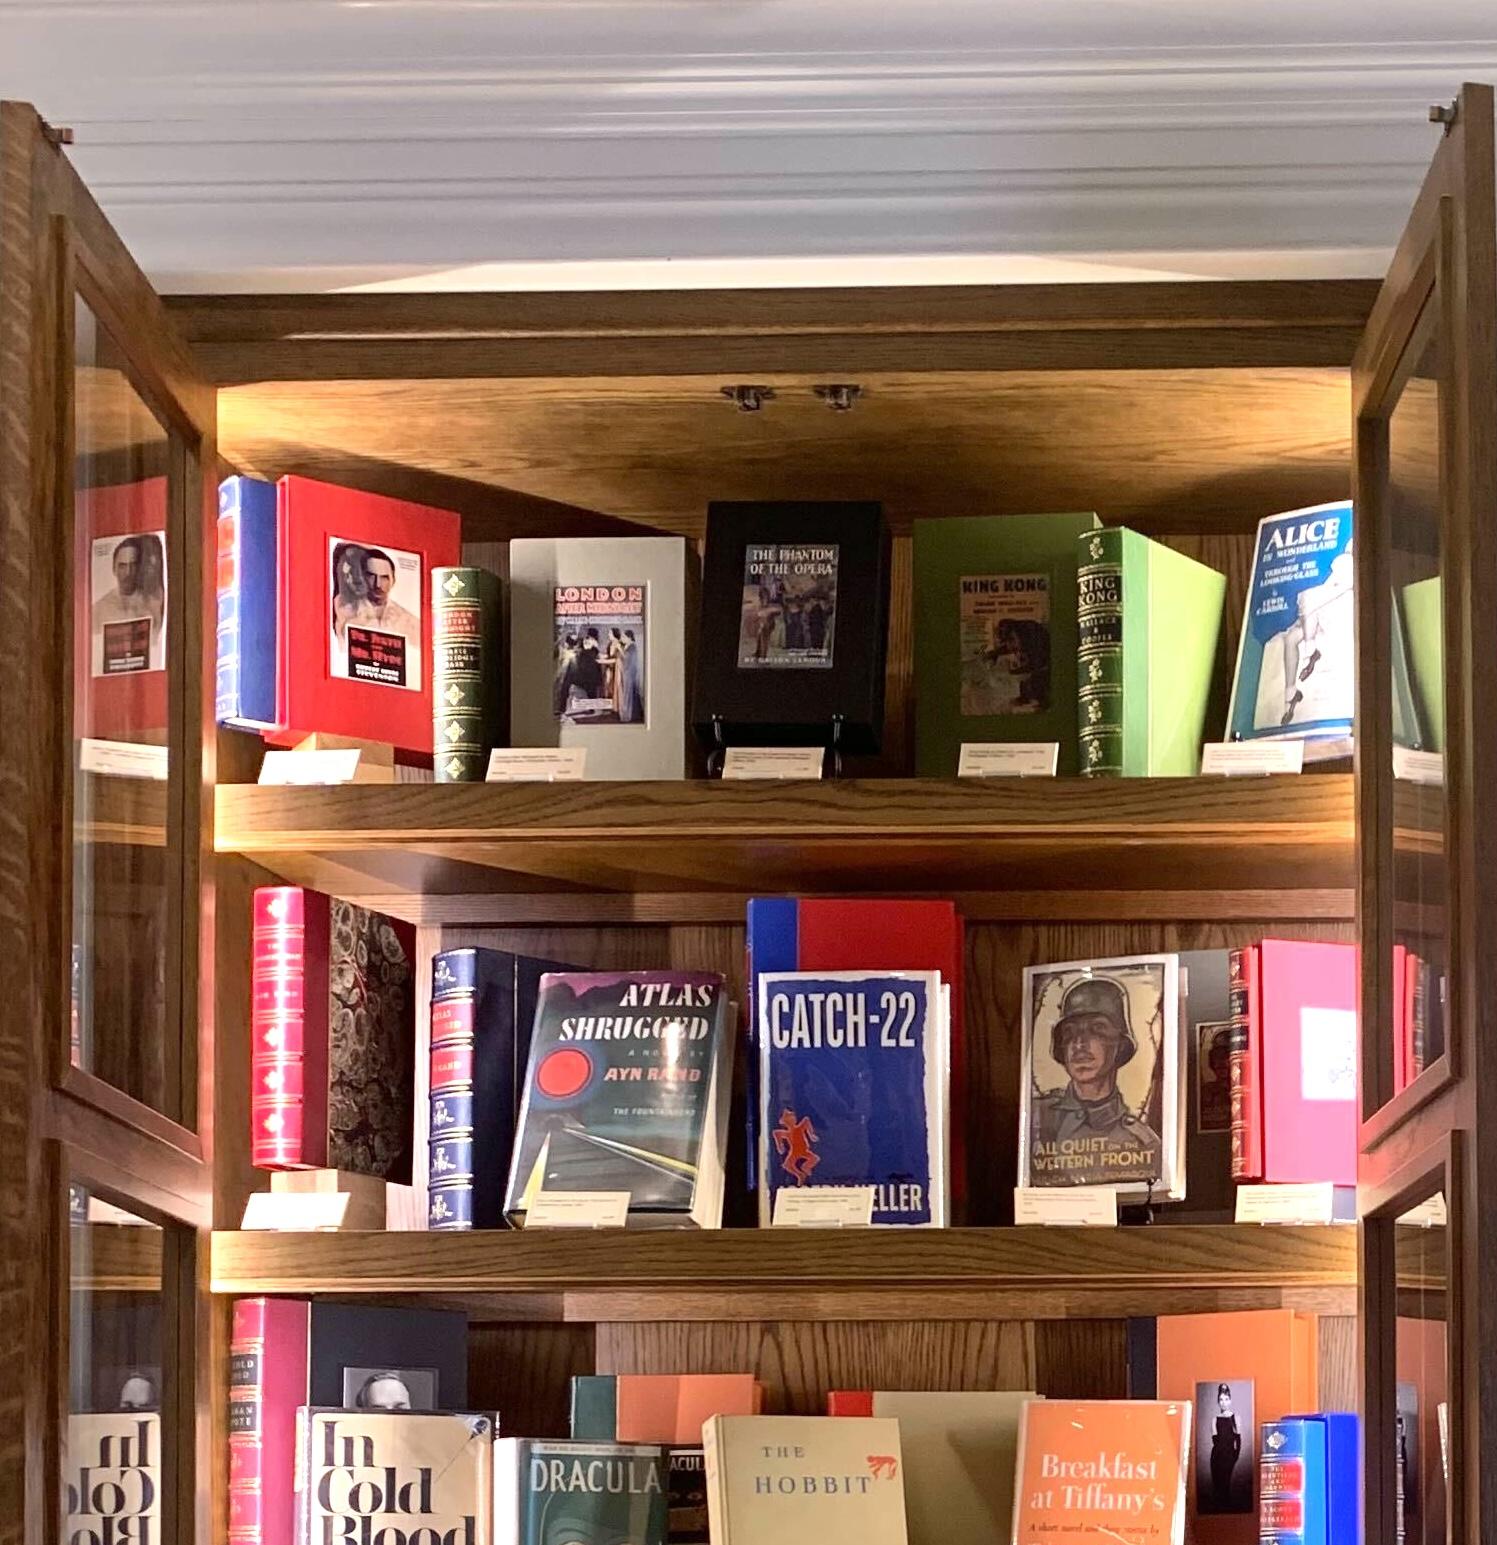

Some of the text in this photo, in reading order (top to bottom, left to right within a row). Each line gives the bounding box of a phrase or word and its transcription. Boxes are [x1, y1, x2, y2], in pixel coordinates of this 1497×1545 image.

[1264, 517, 1340, 552] ALICE
[752, 549, 834, 560] THE PHANTOM
[750, 563, 834, 575] OF THE OPERA
[555, 587, 642, 602] LONDON
[963, 578, 1048, 593] KING KONG
[1080, 577, 1116, 594] KING
[1078, 590, 1118, 607] KONG
[619, 983, 713, 1007] ATLAS
[558, 1016, 709, 1041] SHRUGGED
[771, 991, 917, 1050] CATCH-22
[604, 1067, 701, 1083] AYN RAND
[1035, 1141, 1059, 1156] ALL
[1061, 1137, 1109, 1154] QUIET
[1033, 1150, 1155, 1171] WESTERN FRONT
[322, 1420, 376, 1468] In
[762, 1446, 806, 1459] THE
[531, 1458, 662, 1493] DRACULA
[1040, 1451, 1158, 1481] Breakfast
[318, 1466, 435, 1515] Cold
[755, 1475, 872, 1495] HOBBIT
[1030, 1484, 1166, 1515] at Tiffany's
